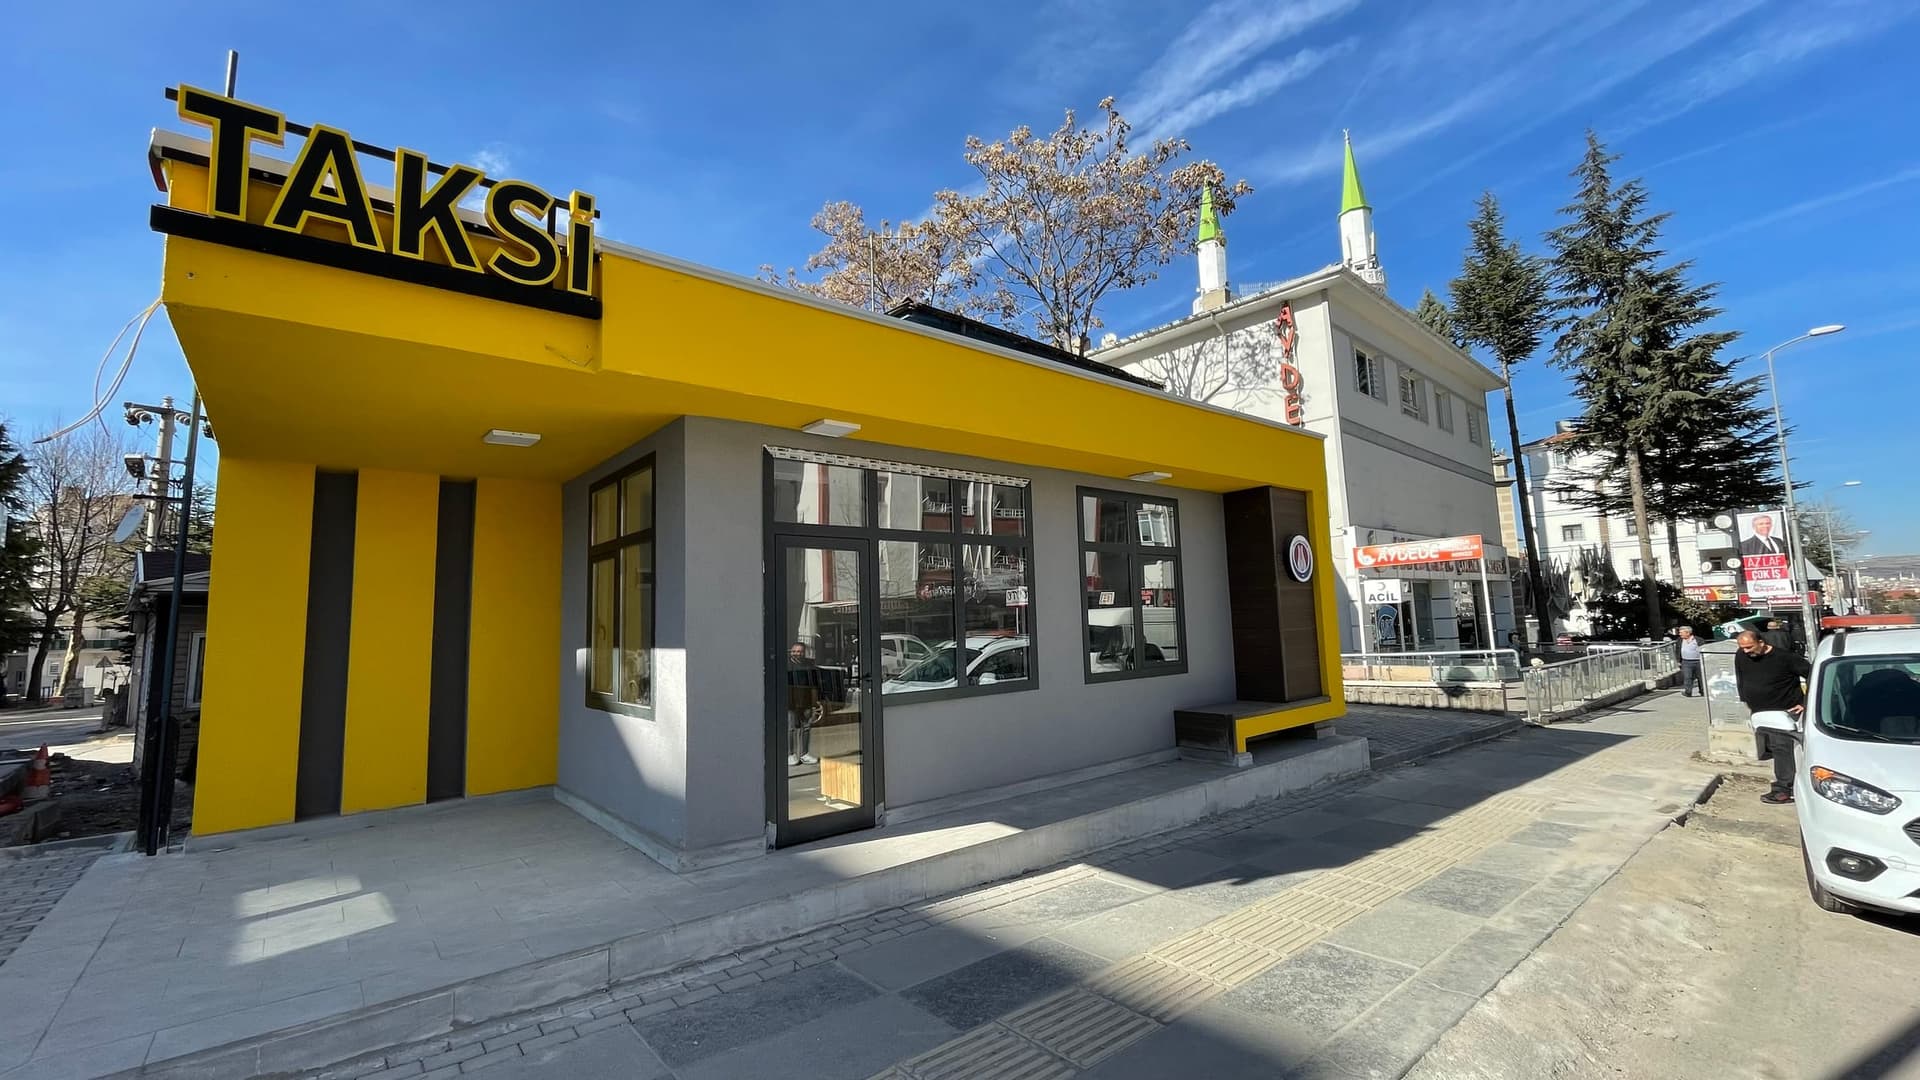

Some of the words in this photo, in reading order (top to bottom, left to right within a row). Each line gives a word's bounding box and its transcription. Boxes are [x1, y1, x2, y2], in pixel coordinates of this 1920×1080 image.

[177, 83, 596, 296] TAKSİ
[1377, 541, 1440, 563] AYDEDE
[1747, 558, 1761, 568] AZ
[1762, 556, 1782, 567] LAF
